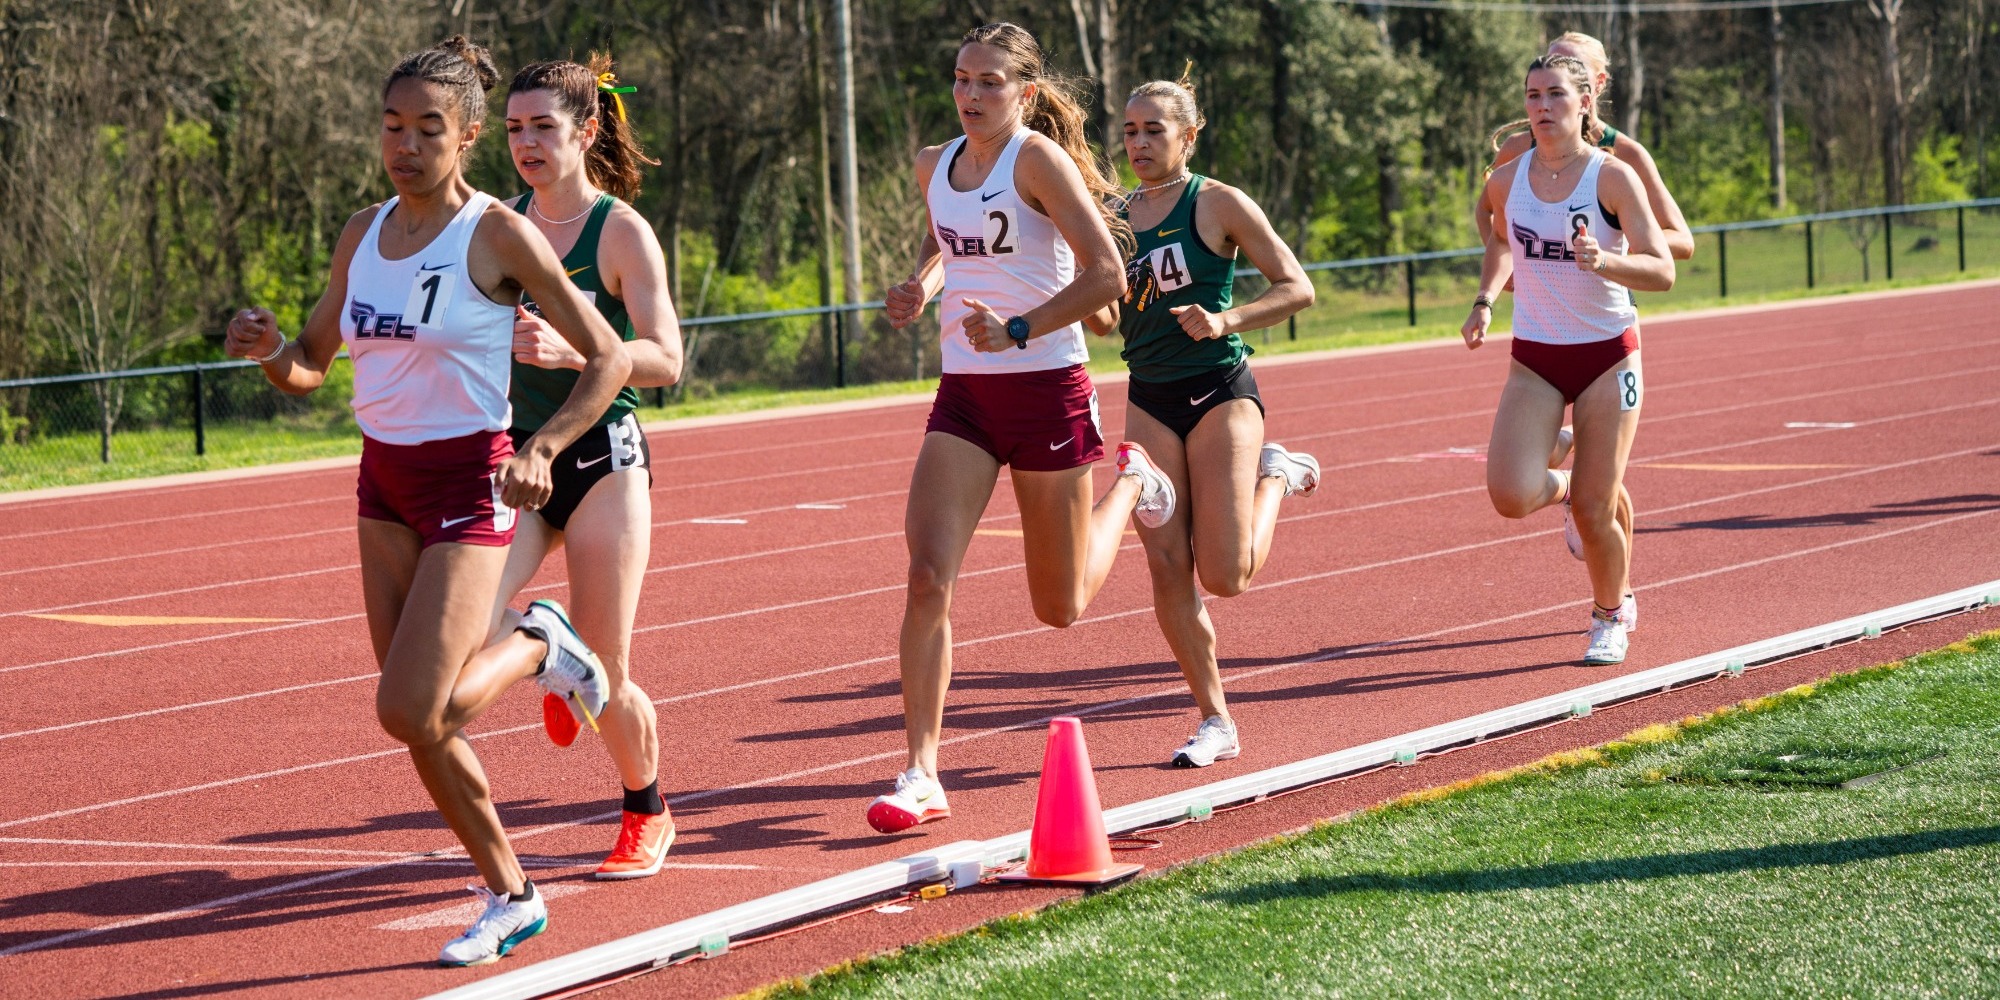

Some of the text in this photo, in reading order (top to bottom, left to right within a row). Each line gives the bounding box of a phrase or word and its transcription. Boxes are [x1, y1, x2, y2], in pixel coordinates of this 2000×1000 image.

[989, 211, 1013, 254] 2
[1161, 247, 1183, 286] 4
[421, 274, 442, 324] 1
[1624, 371, 1637, 407] 8
[615, 418, 637, 467] 3
